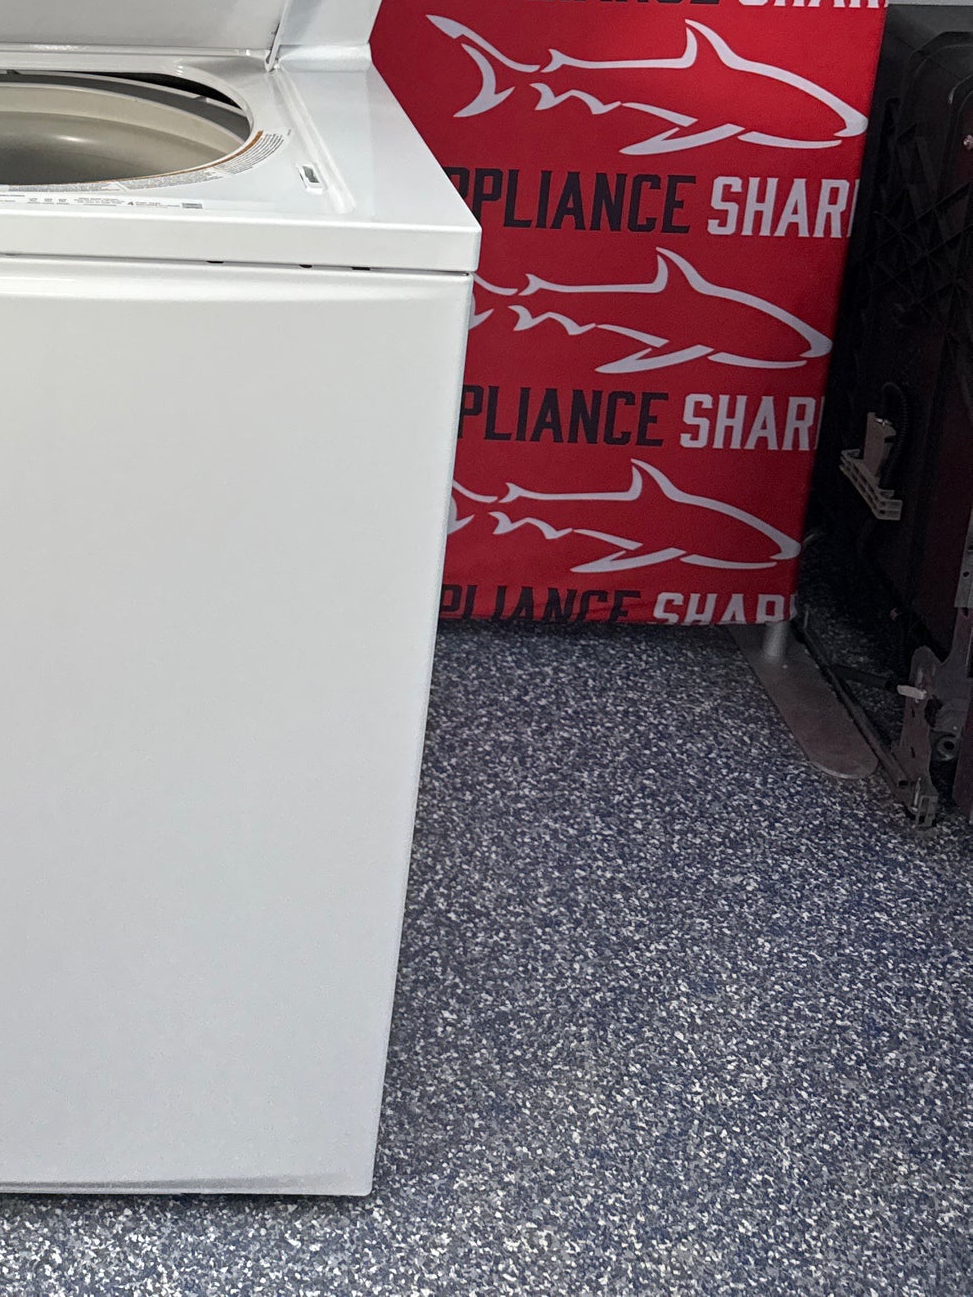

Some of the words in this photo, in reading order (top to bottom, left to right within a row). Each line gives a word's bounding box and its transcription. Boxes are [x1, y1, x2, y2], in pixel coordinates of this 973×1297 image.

[707, 176, 860, 238] SHAR
[679, 393, 824, 452] SHAR
[652, 591, 797, 626] SHAR
